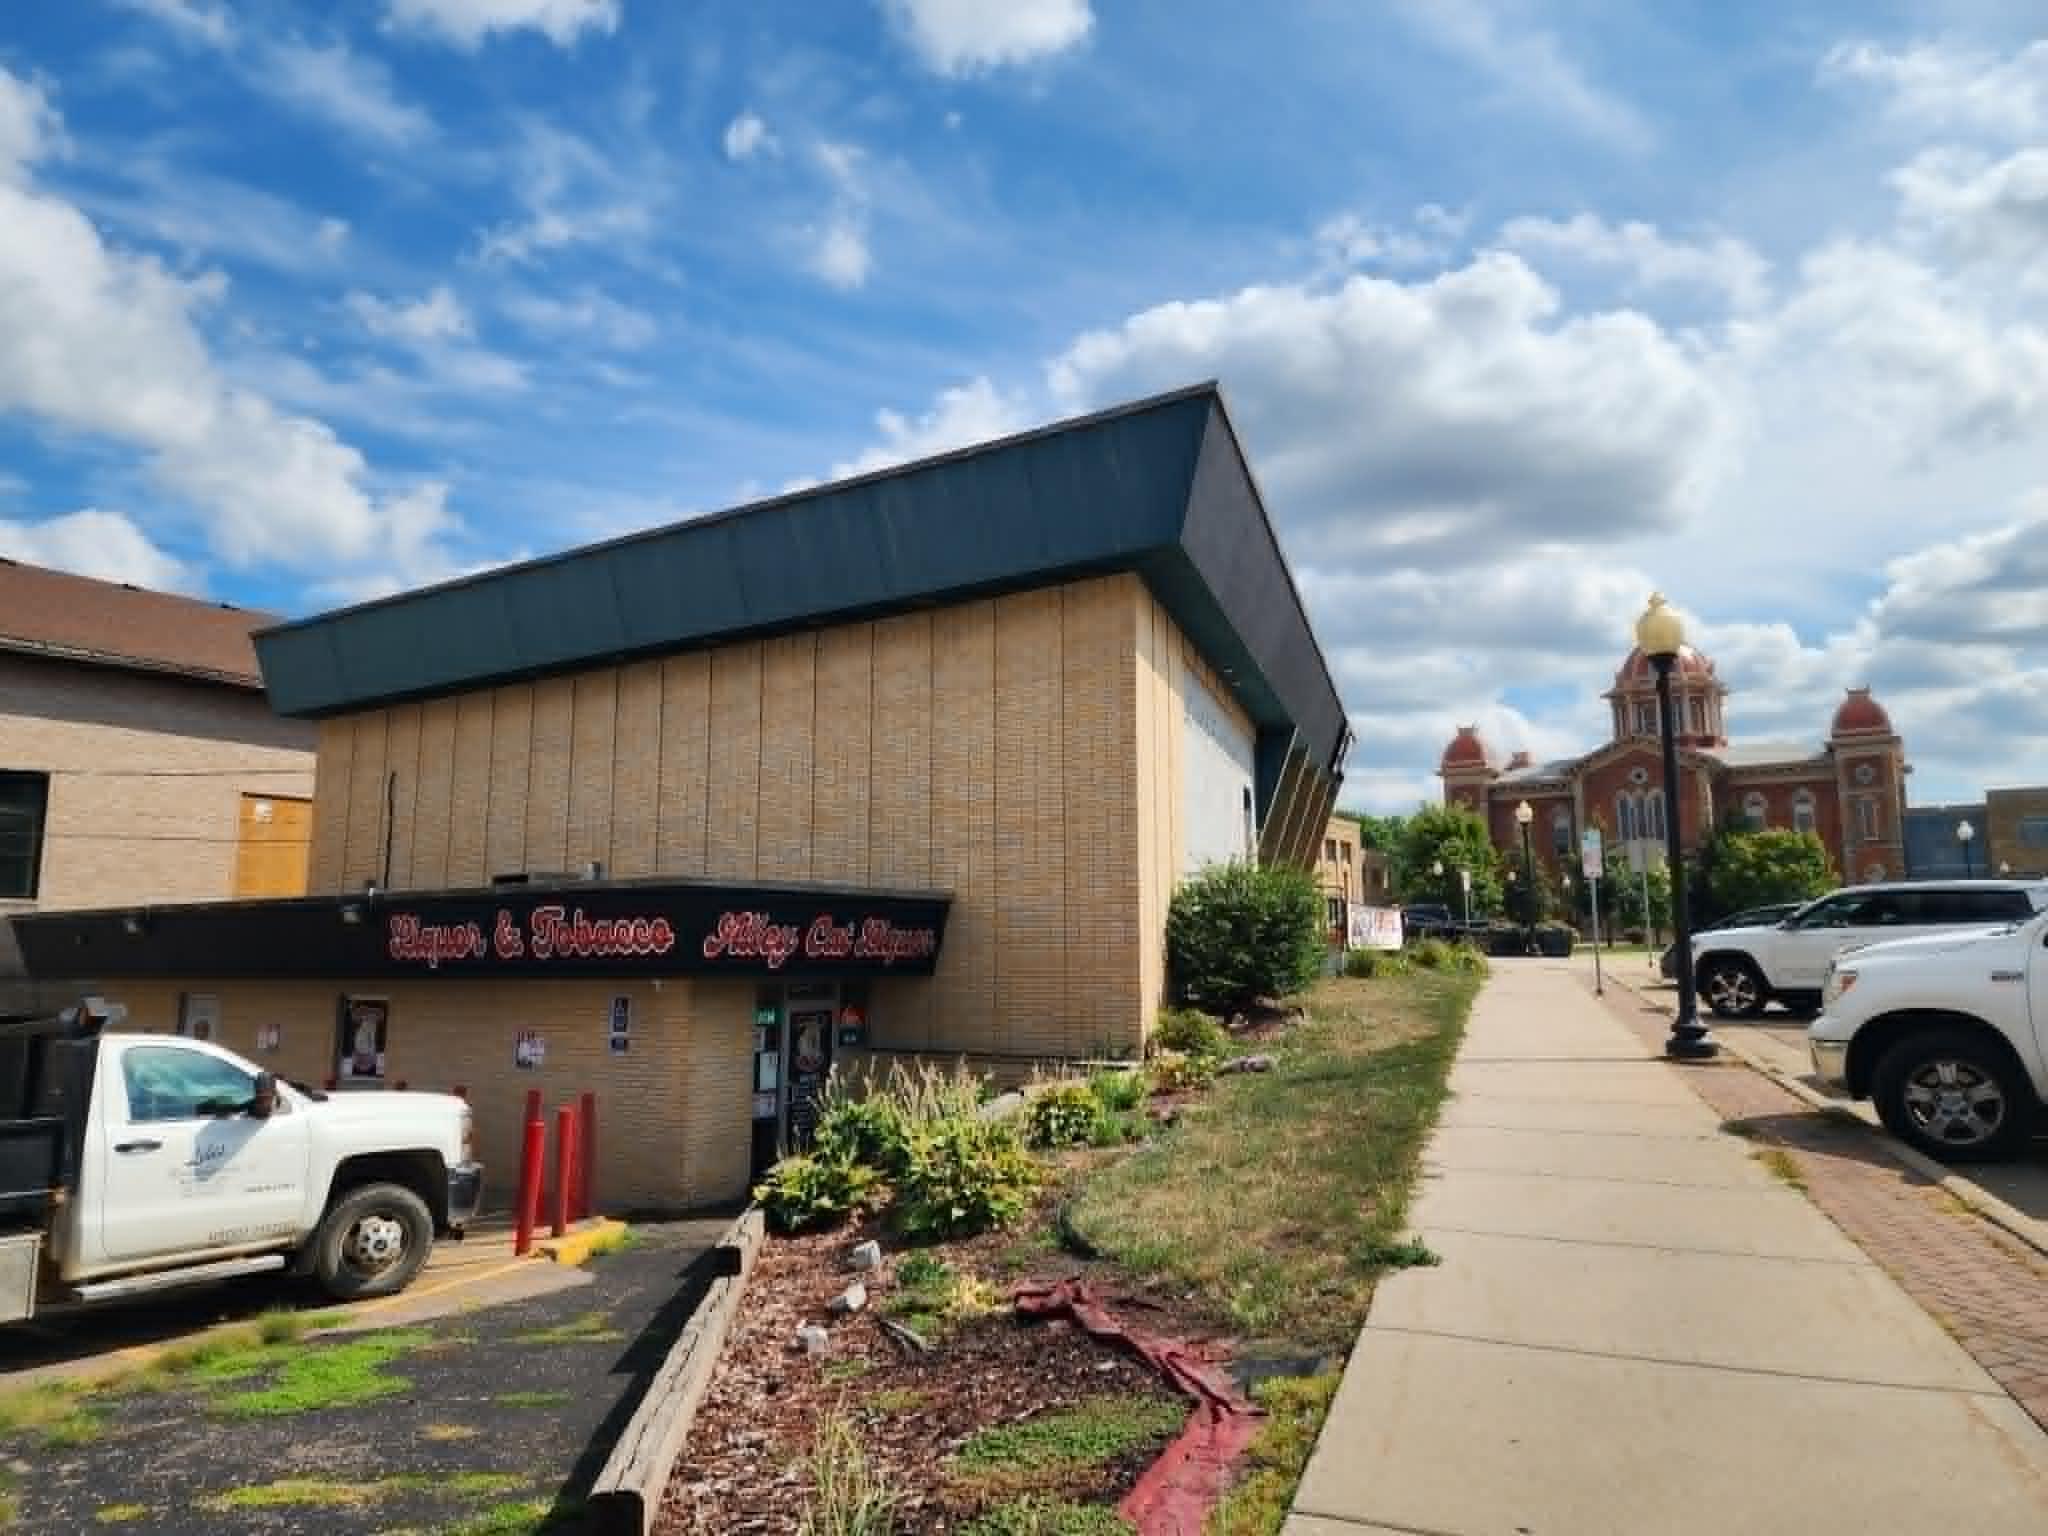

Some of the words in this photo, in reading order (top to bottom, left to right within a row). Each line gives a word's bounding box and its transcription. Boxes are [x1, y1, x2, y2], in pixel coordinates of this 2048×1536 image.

[389, 913, 487, 969] Liquor
[494, 908, 524, 958] &
[531, 904, 676, 960] Tobacco
